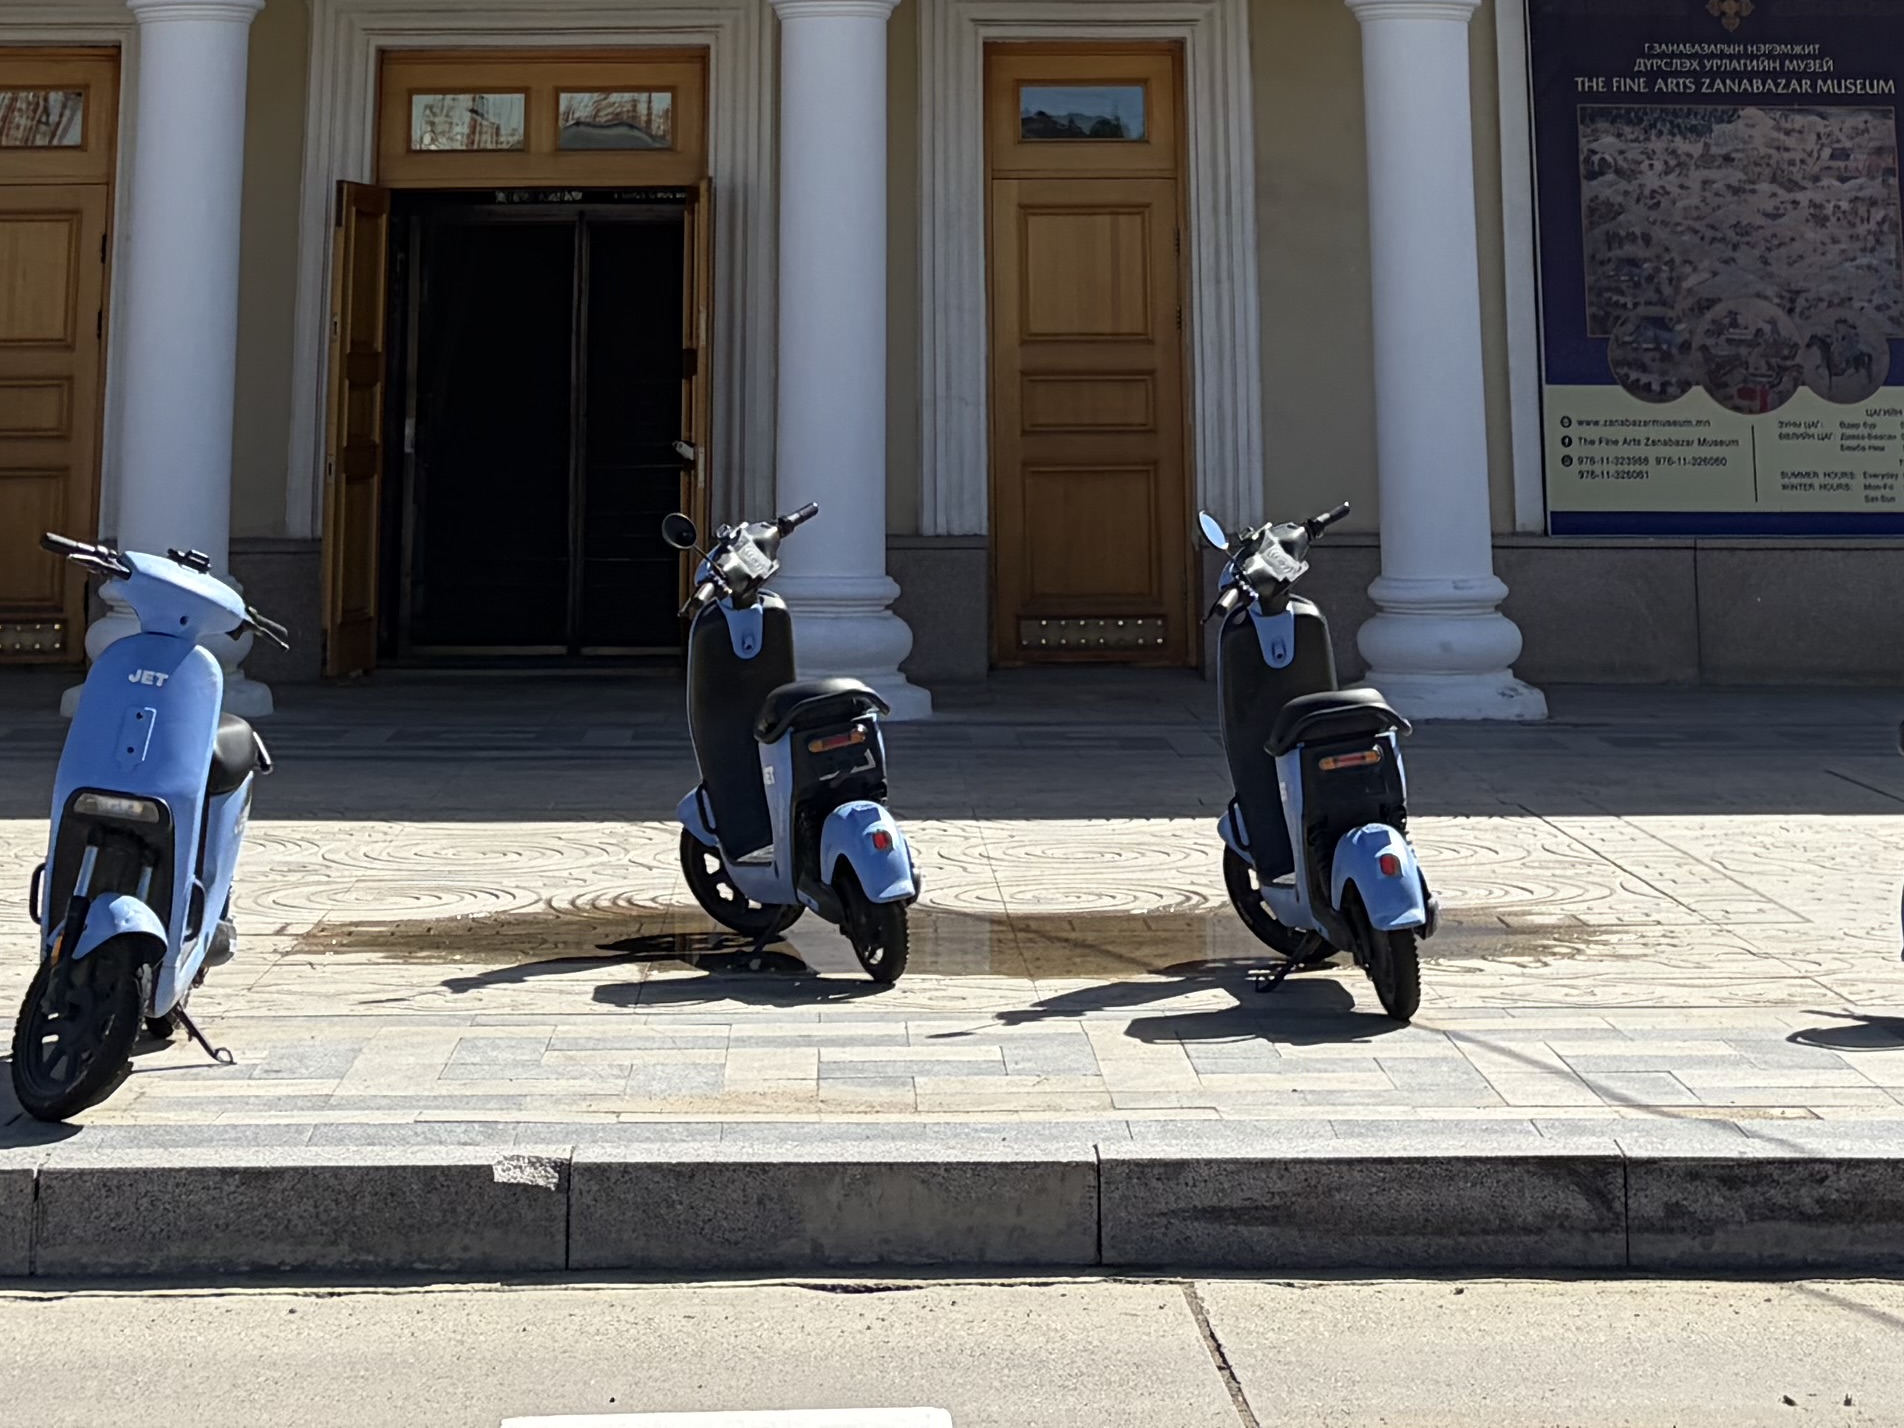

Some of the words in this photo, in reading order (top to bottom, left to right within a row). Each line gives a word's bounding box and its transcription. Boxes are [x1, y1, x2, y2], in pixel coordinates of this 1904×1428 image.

[1634, 58, 1700, 72] ДҮРСЛЭХ
[1704, 56, 1781, 72] УРЛАГИЙН
[1785, 56, 1834, 72] МУЗЕЙ
[1575, 77, 1607, 93] THE
[1612, 77, 1648, 93] FINE
[1654, 77, 1696, 93] ARTS
[1701, 78, 1812, 94] ZANABAZAR
[1816, 78, 1895, 95] MUSEUM
[128, 669, 169, 687] JET
